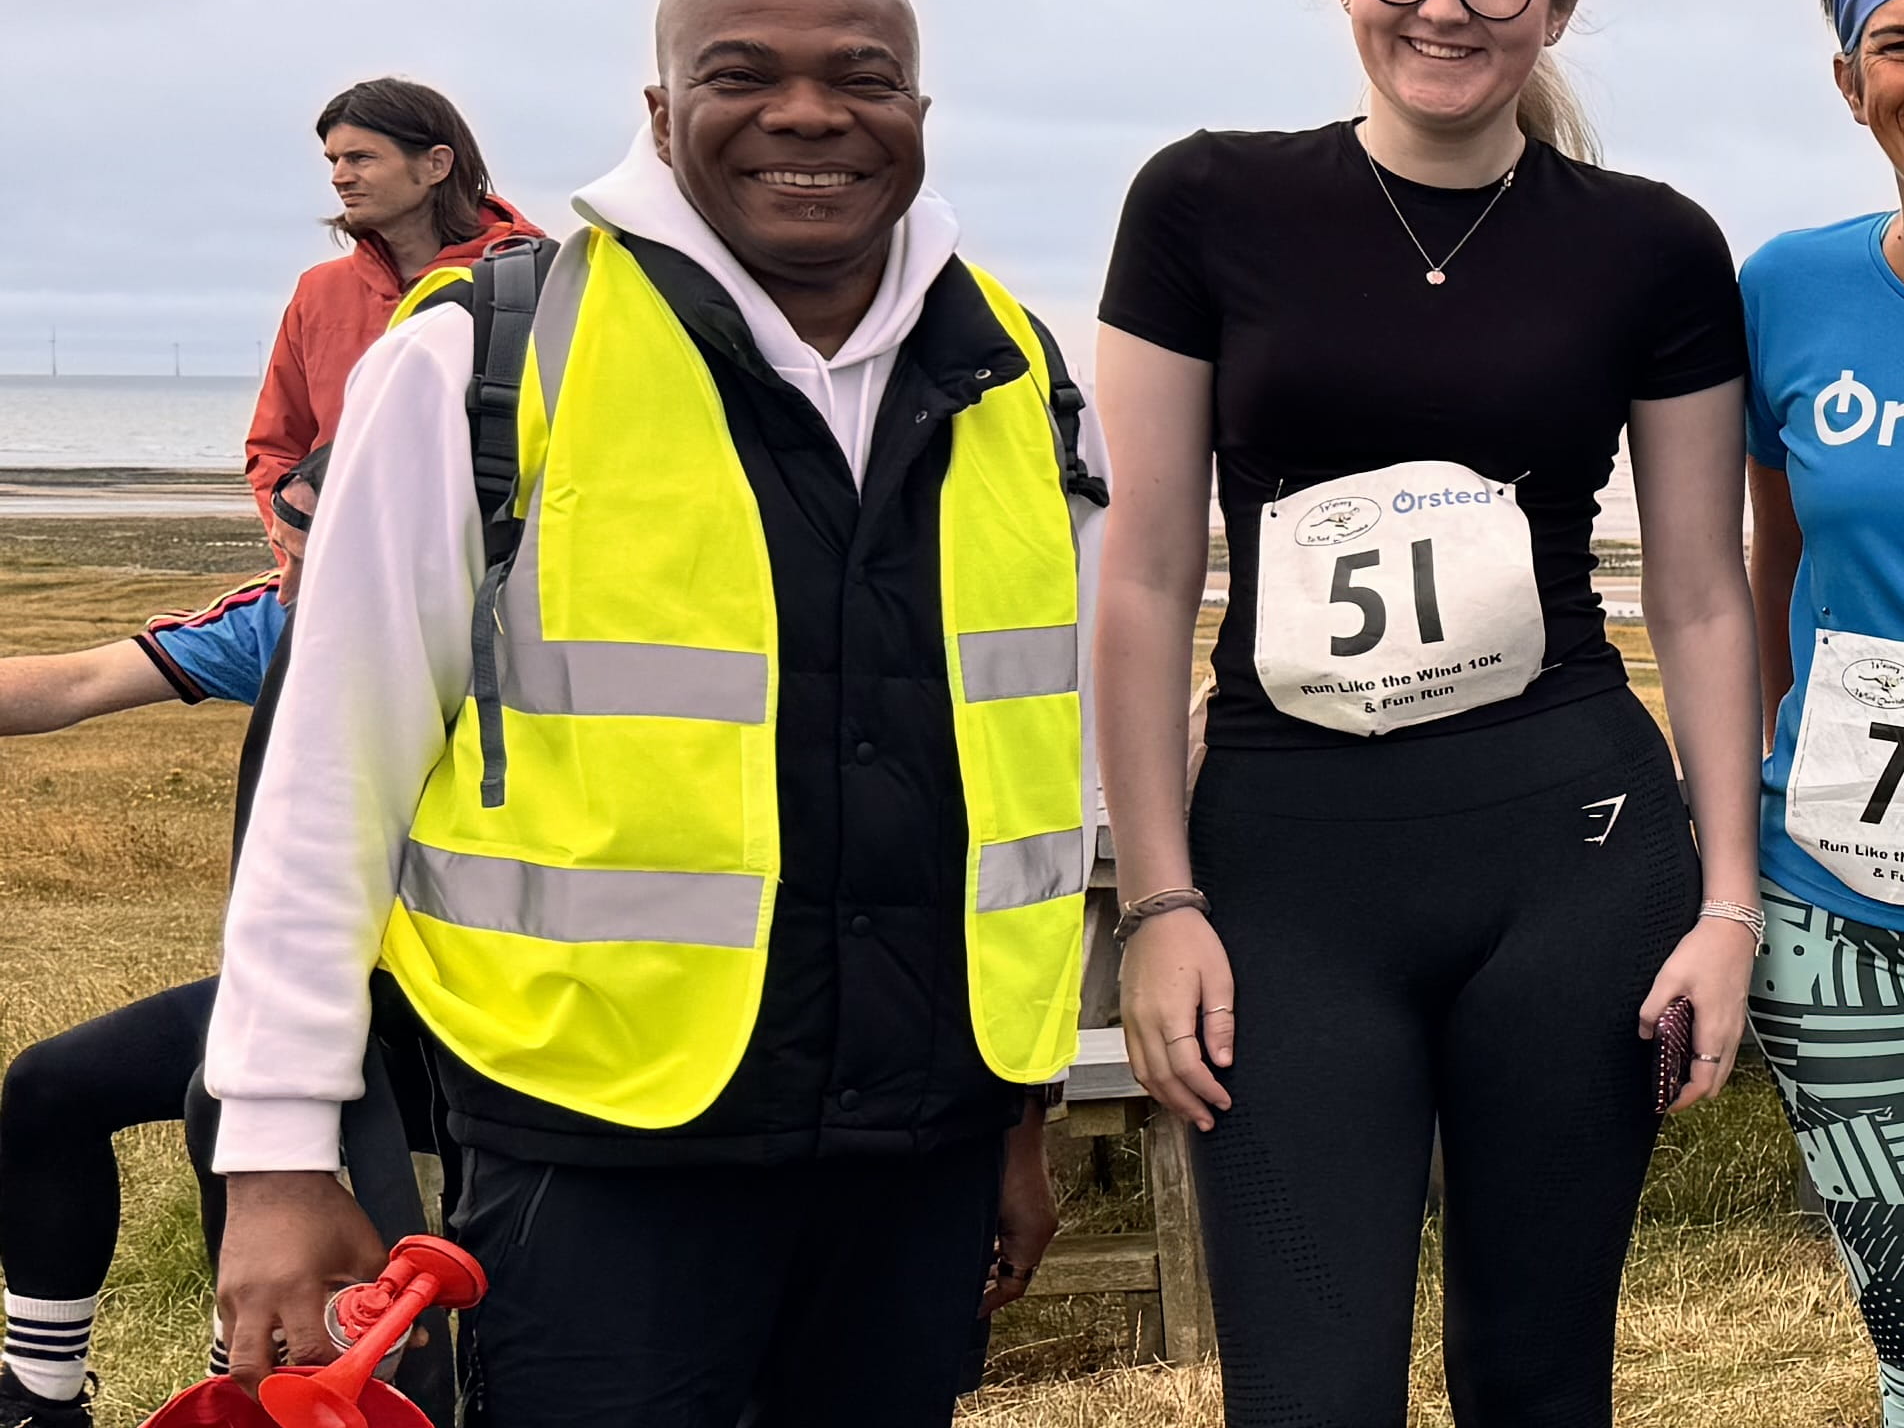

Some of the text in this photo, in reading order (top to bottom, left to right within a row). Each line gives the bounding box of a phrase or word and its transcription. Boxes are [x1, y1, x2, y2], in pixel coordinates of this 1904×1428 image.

[1392, 488, 1491, 513] Ørsted
[1329, 538, 1444, 656] 51
[1301, 652, 1503, 696] Run Like the Wind 10K
[1365, 685, 1455, 714] & Fun Run
[1819, 839, 1849, 853] Run
[1856, 844, 1888, 859] Like
[1873, 868, 1884, 878] &
